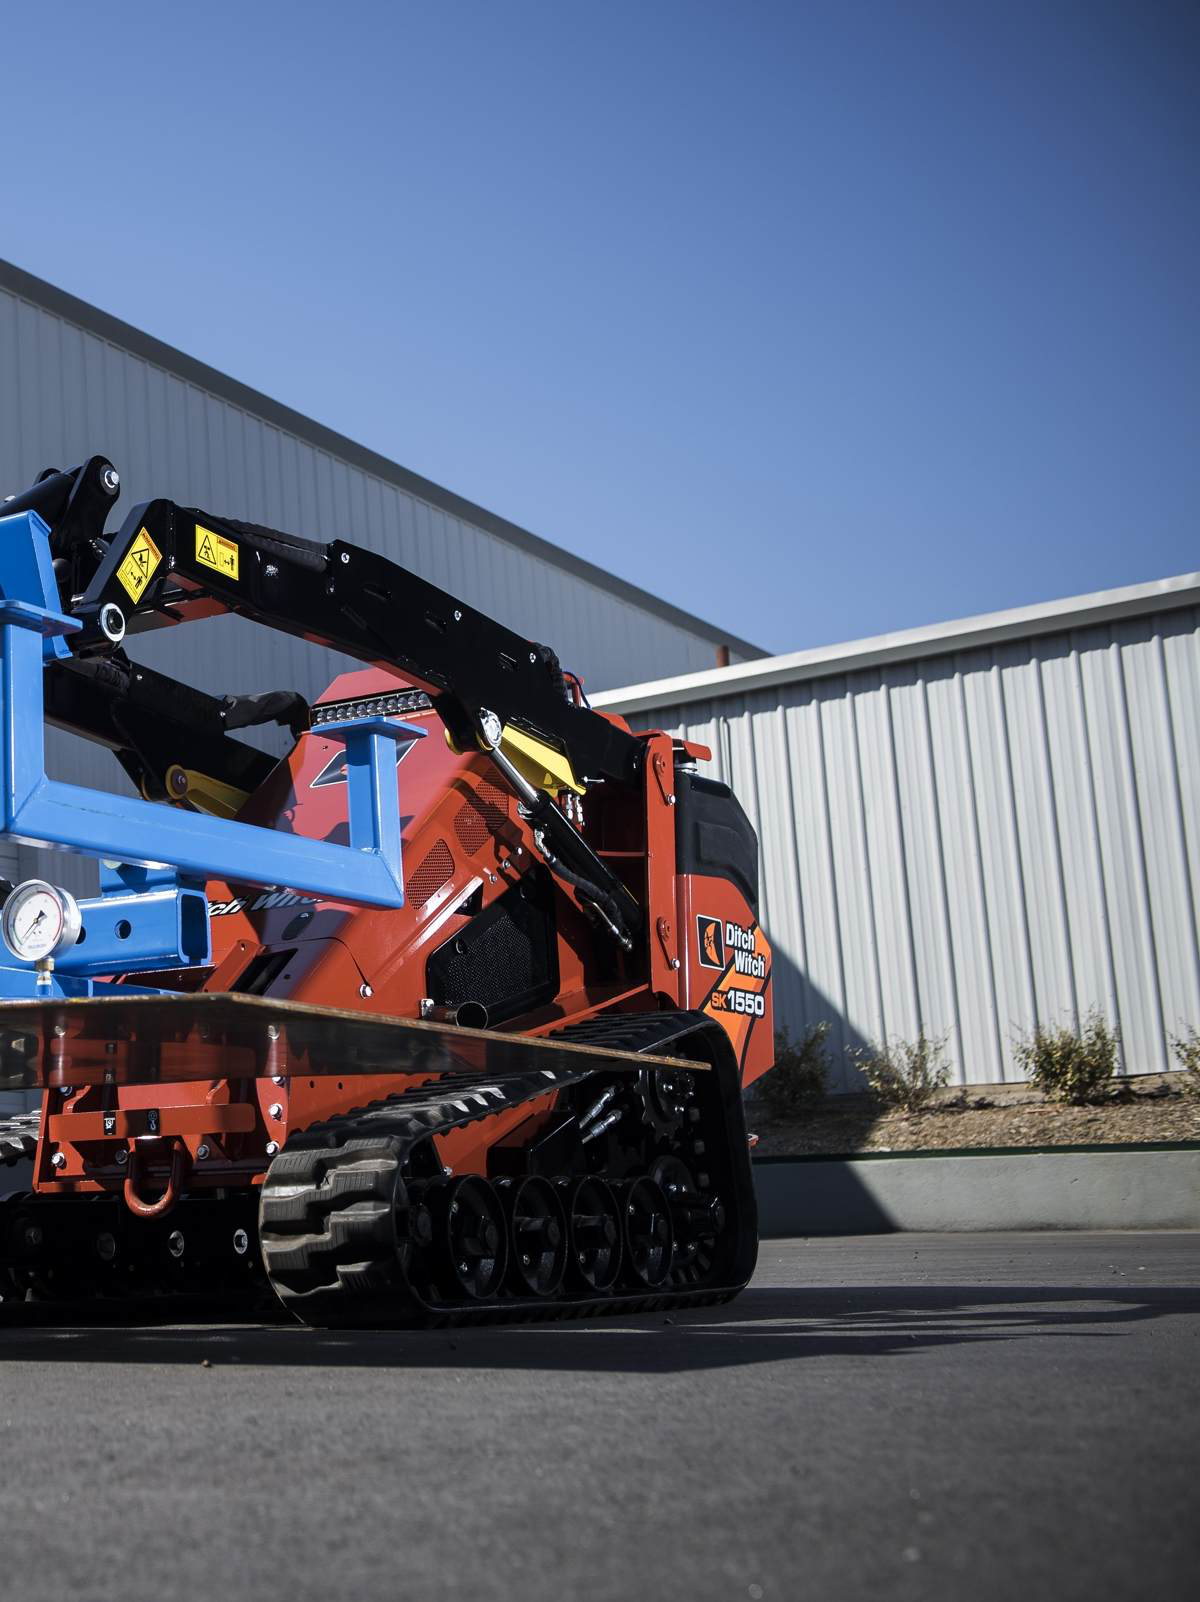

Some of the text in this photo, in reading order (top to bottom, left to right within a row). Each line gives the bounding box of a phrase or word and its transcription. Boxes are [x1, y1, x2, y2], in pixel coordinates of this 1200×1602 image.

[726, 923, 754, 951] Ditch
[735, 950, 765, 977] Witch
[711, 990, 764, 1016] SK 1550
